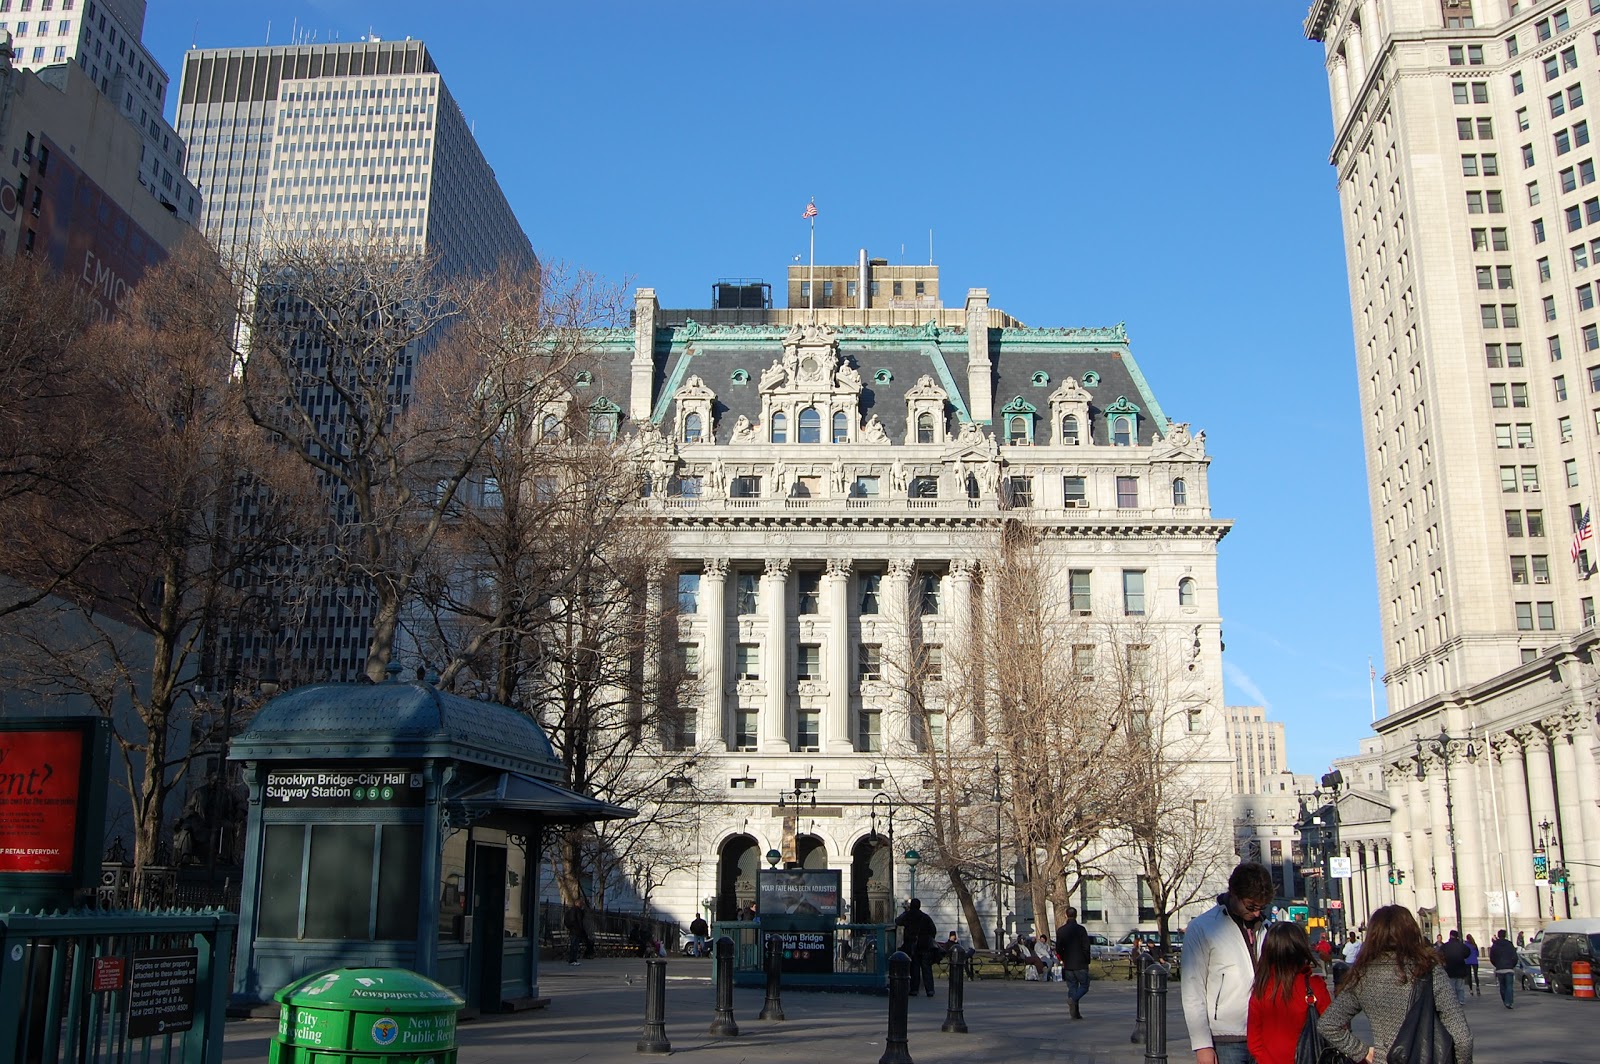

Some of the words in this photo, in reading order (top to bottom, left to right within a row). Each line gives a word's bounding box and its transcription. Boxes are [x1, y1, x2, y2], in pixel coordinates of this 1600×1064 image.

[267, 774, 315, 787] Brooklyn
[317, 774, 381, 787] Bridge-City
[383, 773, 405, 784] Hall
[266, 786, 312, 799] Subway
[311, 786, 351, 797] Station
[800, 933, 824, 942] Bridge
[135, 962, 153, 971] Bicycles
[172, 960, 190, 969] property
[134, 971, 154, 979] attached
[173, 969, 188, 977] railings
[141, 989, 152, 997] Lost
[152, 988, 170, 996] Property
[351, 988, 416, 1000] Newspapers
[418, 991, 429, 999] &
[131, 999, 149, 1007] located
[143, 1007, 155, 1016] (212)
[297, 1011, 318, 1029] City
[408, 1016, 432, 1029] New
[434, 1015, 450, 1028] York
[402, 1030, 435, 1043] Public
